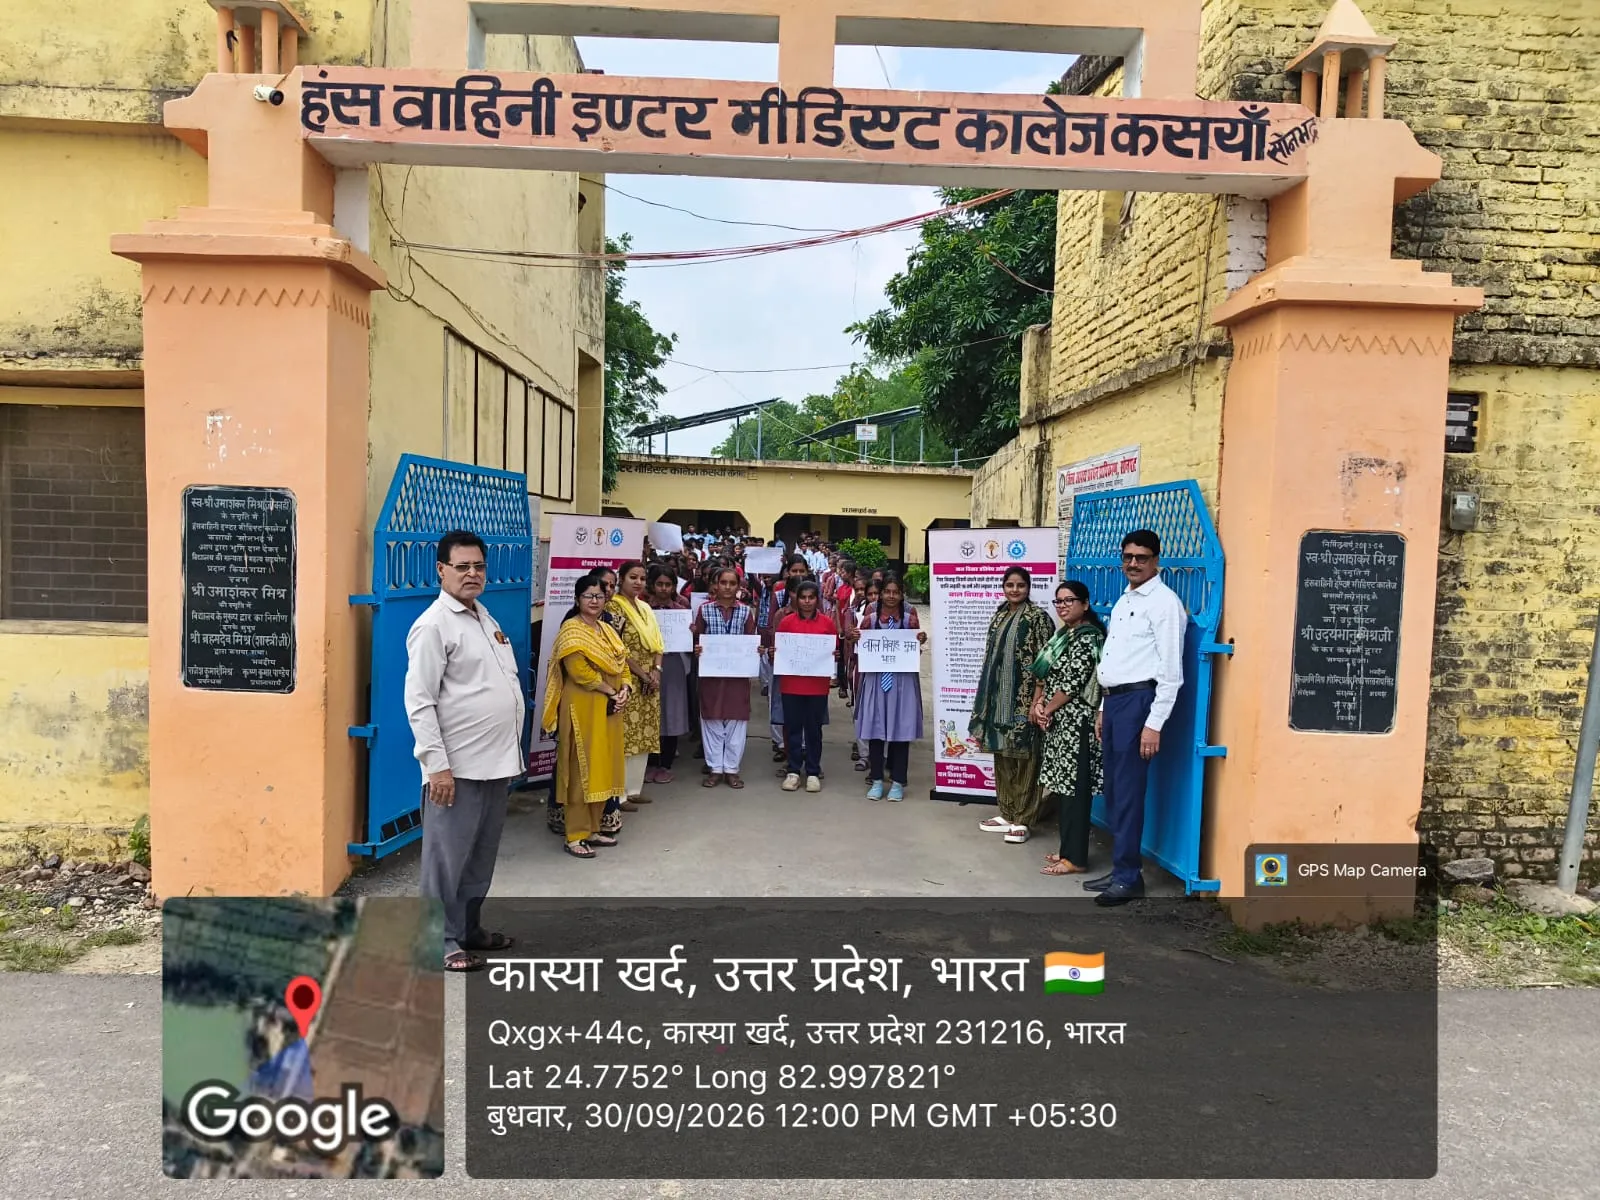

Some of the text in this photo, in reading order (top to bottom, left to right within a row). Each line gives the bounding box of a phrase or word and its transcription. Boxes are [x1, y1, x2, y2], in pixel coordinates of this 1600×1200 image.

[301, 70, 385, 133] हंस
[393, 75, 562, 139] वाहिनी
[572, 91, 718, 142] इण्टर
[955, 97, 1109, 156] कालेज
[208, 585, 258, 599] उमाशंकर
[262, 585, 287, 599] मिश्र
